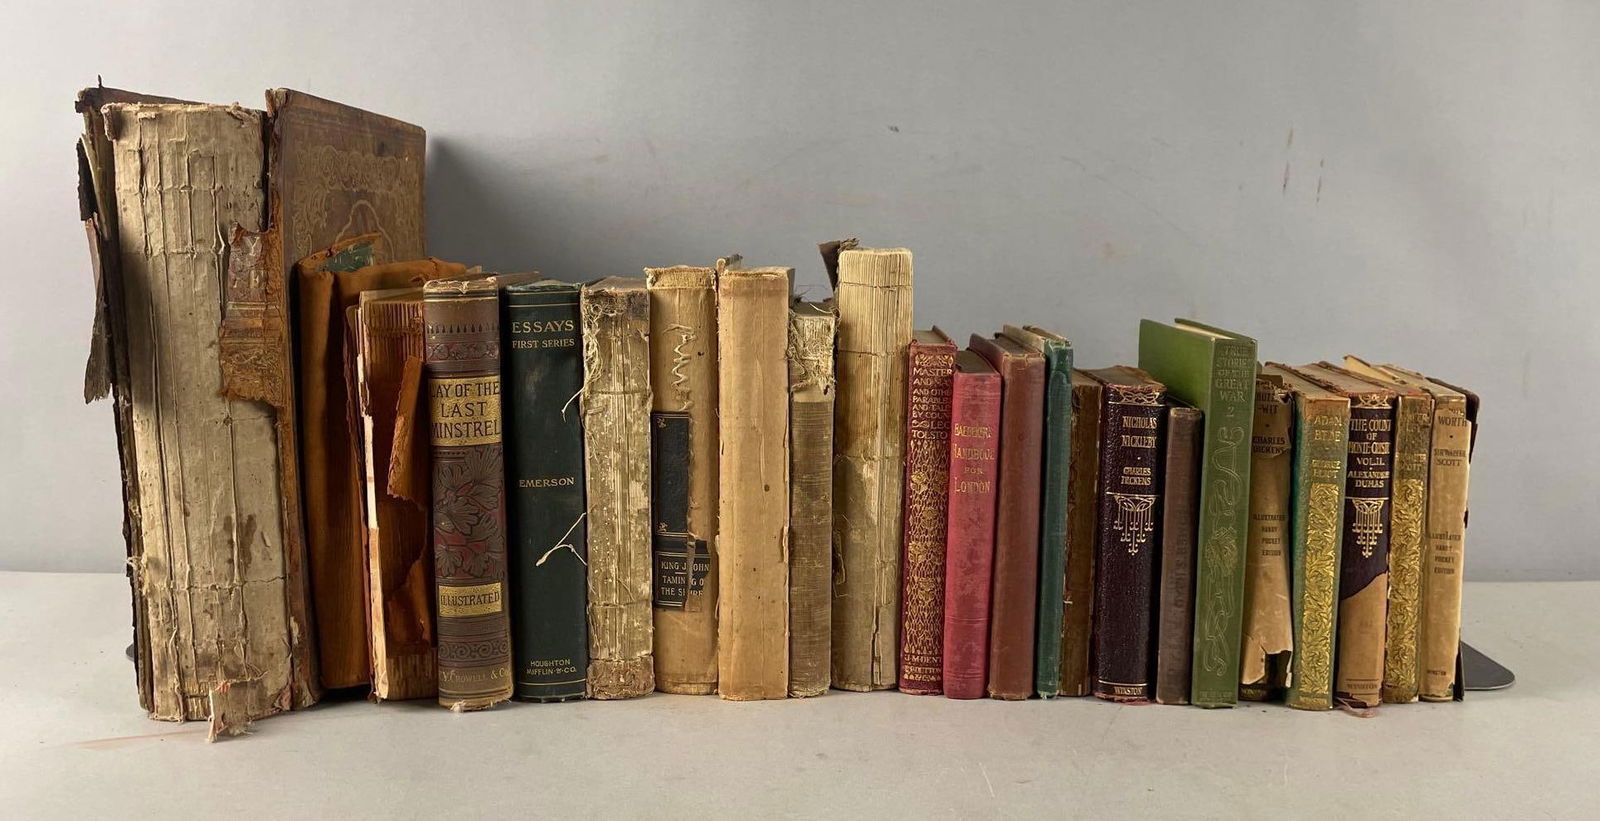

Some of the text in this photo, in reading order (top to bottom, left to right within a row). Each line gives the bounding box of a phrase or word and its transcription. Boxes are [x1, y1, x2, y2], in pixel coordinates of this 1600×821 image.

[512, 320, 574, 333] ESSAYS
[512, 338, 575, 349] FIRST SERIES
[913, 367, 953, 377] MASTER
[913, 378, 931, 386] AND
[455, 382, 471, 397] OF
[476, 380, 500, 396] THE
[912, 388, 929, 396] AND
[1220, 390, 1246, 402] WAR
[441, 401, 487, 418] LAST
[912, 404, 928, 412] AND
[912, 411, 923, 419] BY
[1122, 415, 1157, 429] NICHOLAS
[1314, 415, 1342, 426] ADAM
[1350, 419, 1368, 431] THE
[1368, 419, 1392, 431] COUNT
[1314, 429, 1341, 442] BEDE
[1366, 432, 1378, 441] OF
[1121, 435, 1157, 448] NICKLEBY
[1437, 458, 1462, 466] SCOTT
[964, 466, 984, 475] FOR
[1123, 466, 1151, 476] CHARLES
[1347, 470, 1390, 479] ALEXANDRE
[519, 477, 574, 488] EMERSON
[954, 476, 991, 493] LONDON
[1121, 476, 1152, 485] DICKENS
[1355, 479, 1385, 488] DUMAS
[661, 561, 679, 570] KING
[661, 587, 675, 596] THE
[440, 591, 500, 606] ILLUSTRATED
[530, 658, 571, 667] HOUGHTON
[490, 670, 498, 680] &
[1114, 686, 1143, 695] WINSTON
